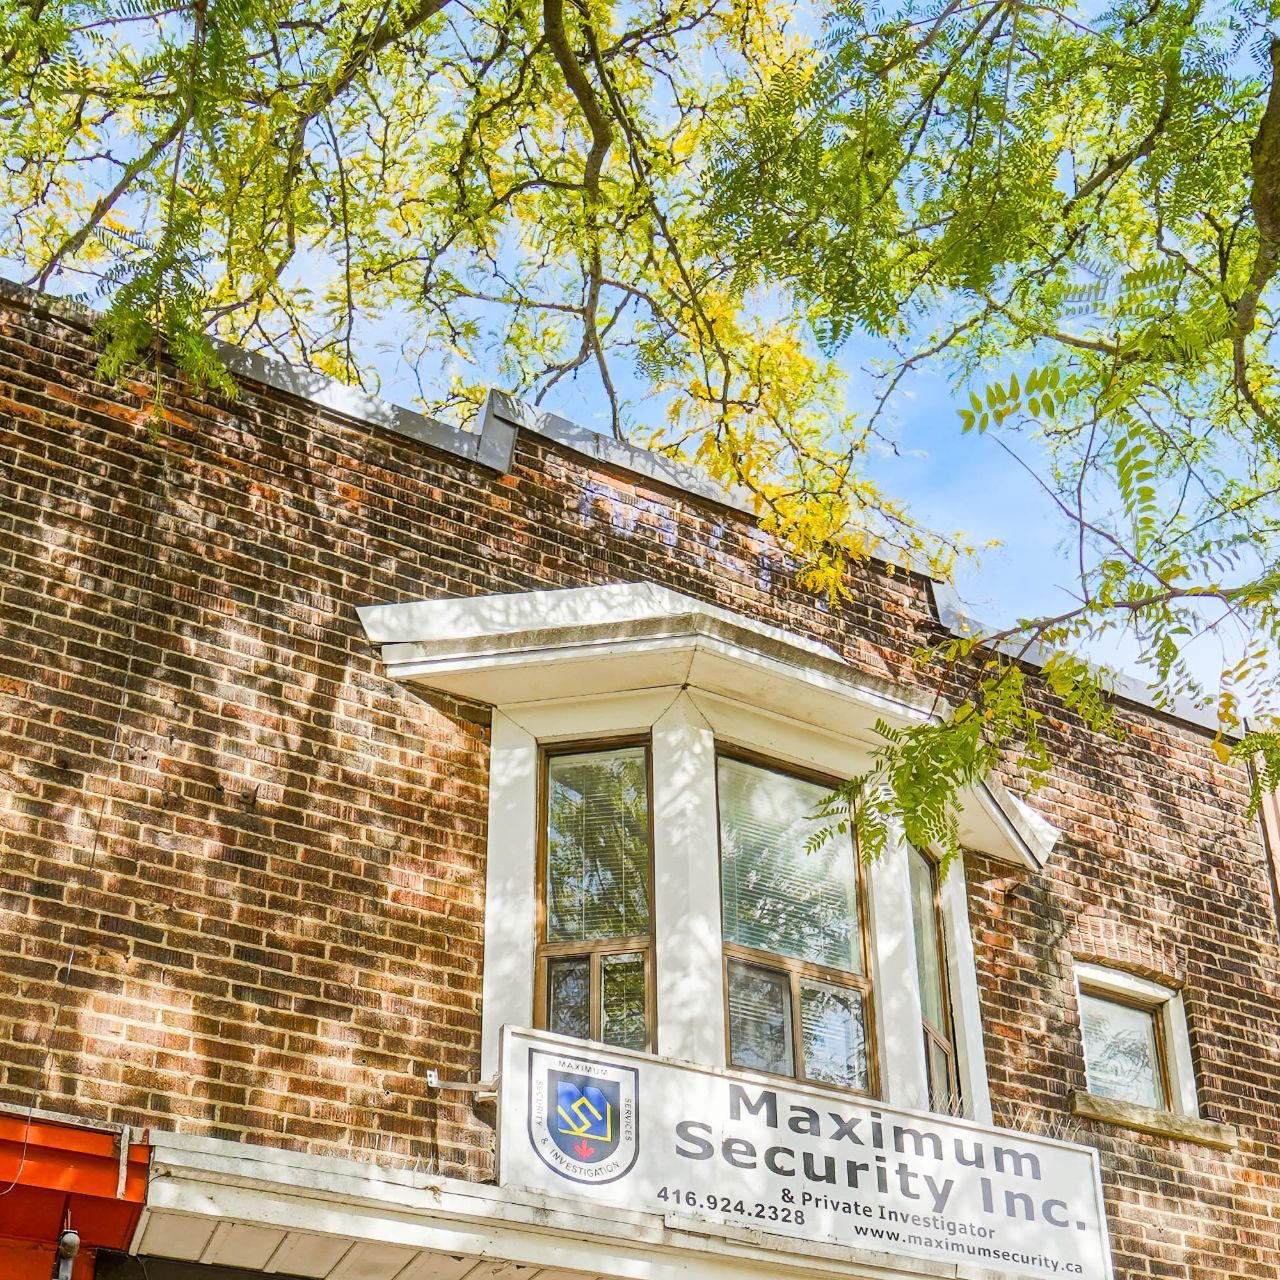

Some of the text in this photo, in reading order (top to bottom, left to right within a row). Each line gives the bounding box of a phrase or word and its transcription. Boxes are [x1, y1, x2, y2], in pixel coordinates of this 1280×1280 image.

[558, 1060, 608, 1077] MAXIMUM
[535, 1079, 545, 1127] SECURITY
[549, 1148, 621, 1178] INVESTIGATION
[624, 1097, 633, 1142] SERVICES
[729, 1083, 1042, 1181] Maximum
[675, 1120, 1086, 1231] Security Inc.
[656, 1186, 806, 1226] 416.924.2328
[781, 1187, 996, 1240] & Private Investigator
[854, 1224, 1084, 1275] www.maximumsecurity.ca
